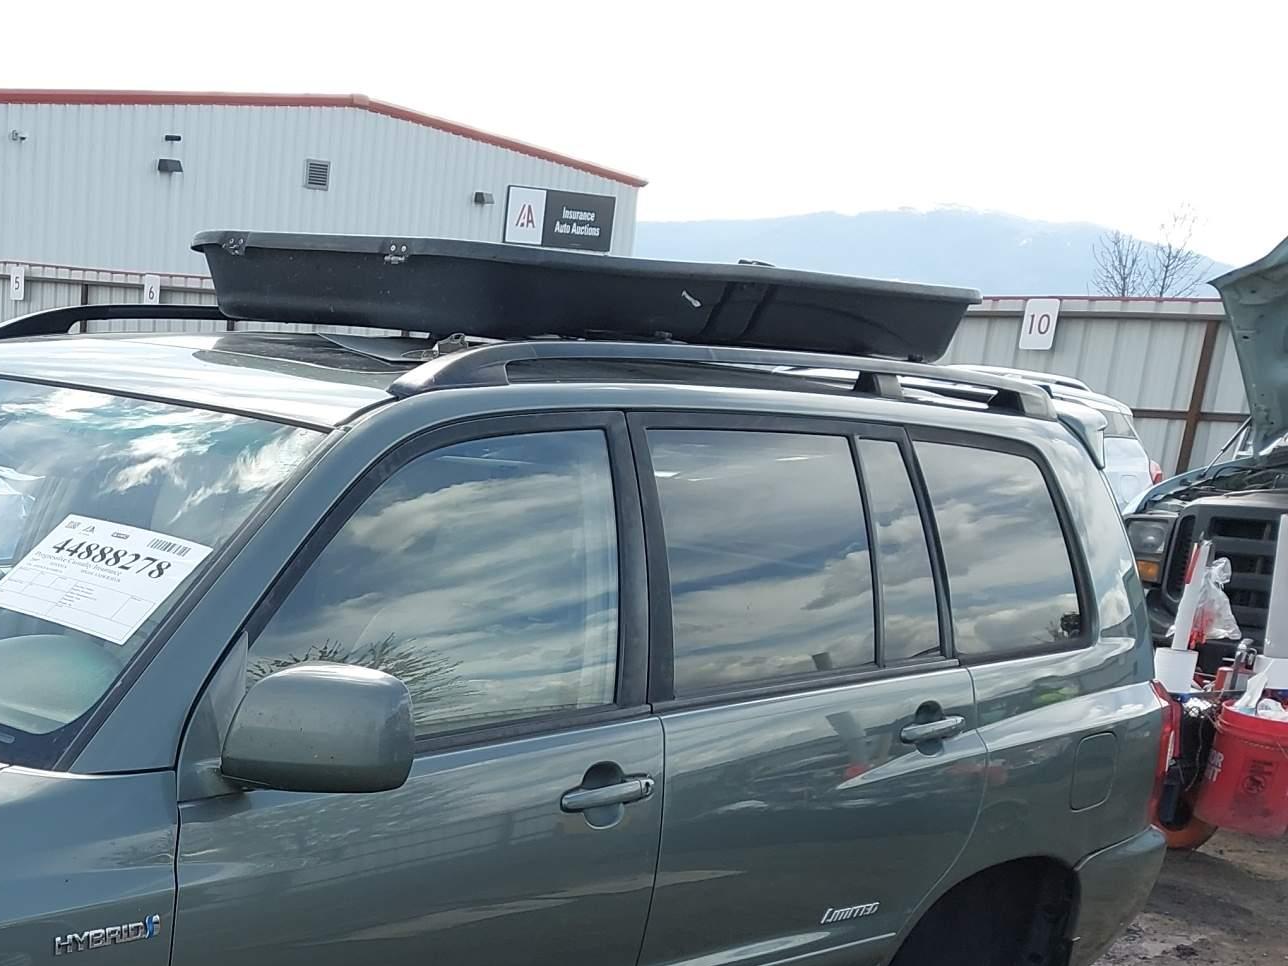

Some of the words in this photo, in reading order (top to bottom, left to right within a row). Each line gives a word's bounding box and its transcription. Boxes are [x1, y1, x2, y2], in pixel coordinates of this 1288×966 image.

[562, 206, 595, 221] Insurance
[554, 221, 570, 234] Auto
[571, 223, 600, 236] Auctions
[14, 276, 20, 290] 5
[148, 286, 155, 300] 6
[1028, 314, 1051, 335] 10
[52, 538, 172, 579] 44888278
[54, 921, 148, 956] HYBRID
